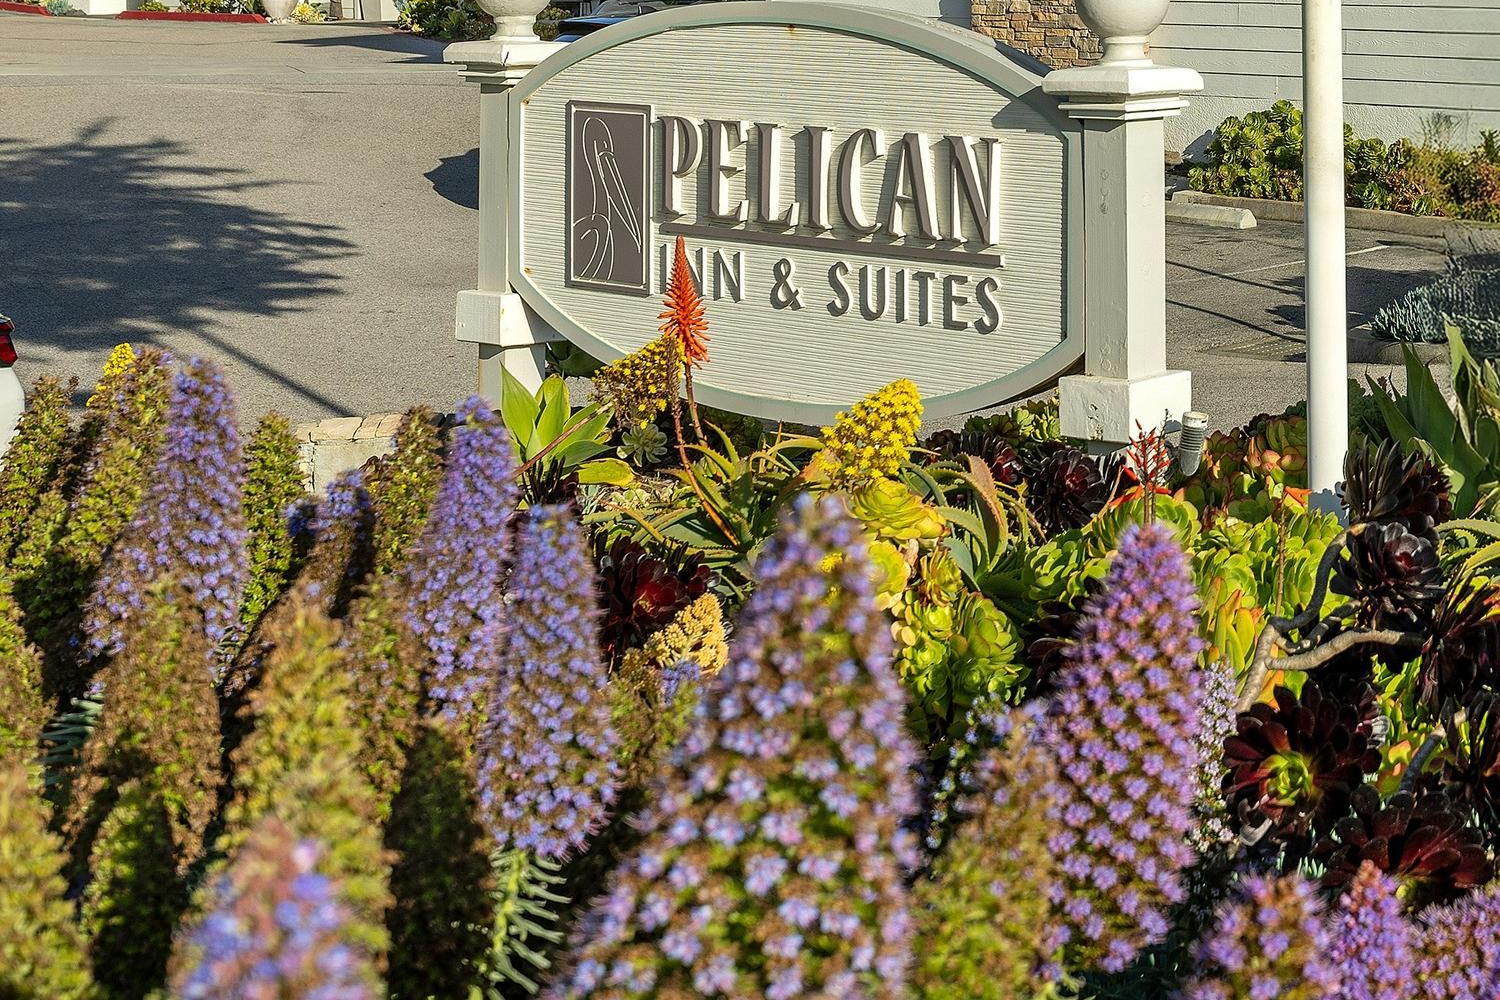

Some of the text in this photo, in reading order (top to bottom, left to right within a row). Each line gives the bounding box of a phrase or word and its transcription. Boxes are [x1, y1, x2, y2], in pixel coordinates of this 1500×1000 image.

[657, 115, 1004, 247] PELICAN
[769, 257, 805, 311] &
[827, 261, 1003, 335] SUITES
